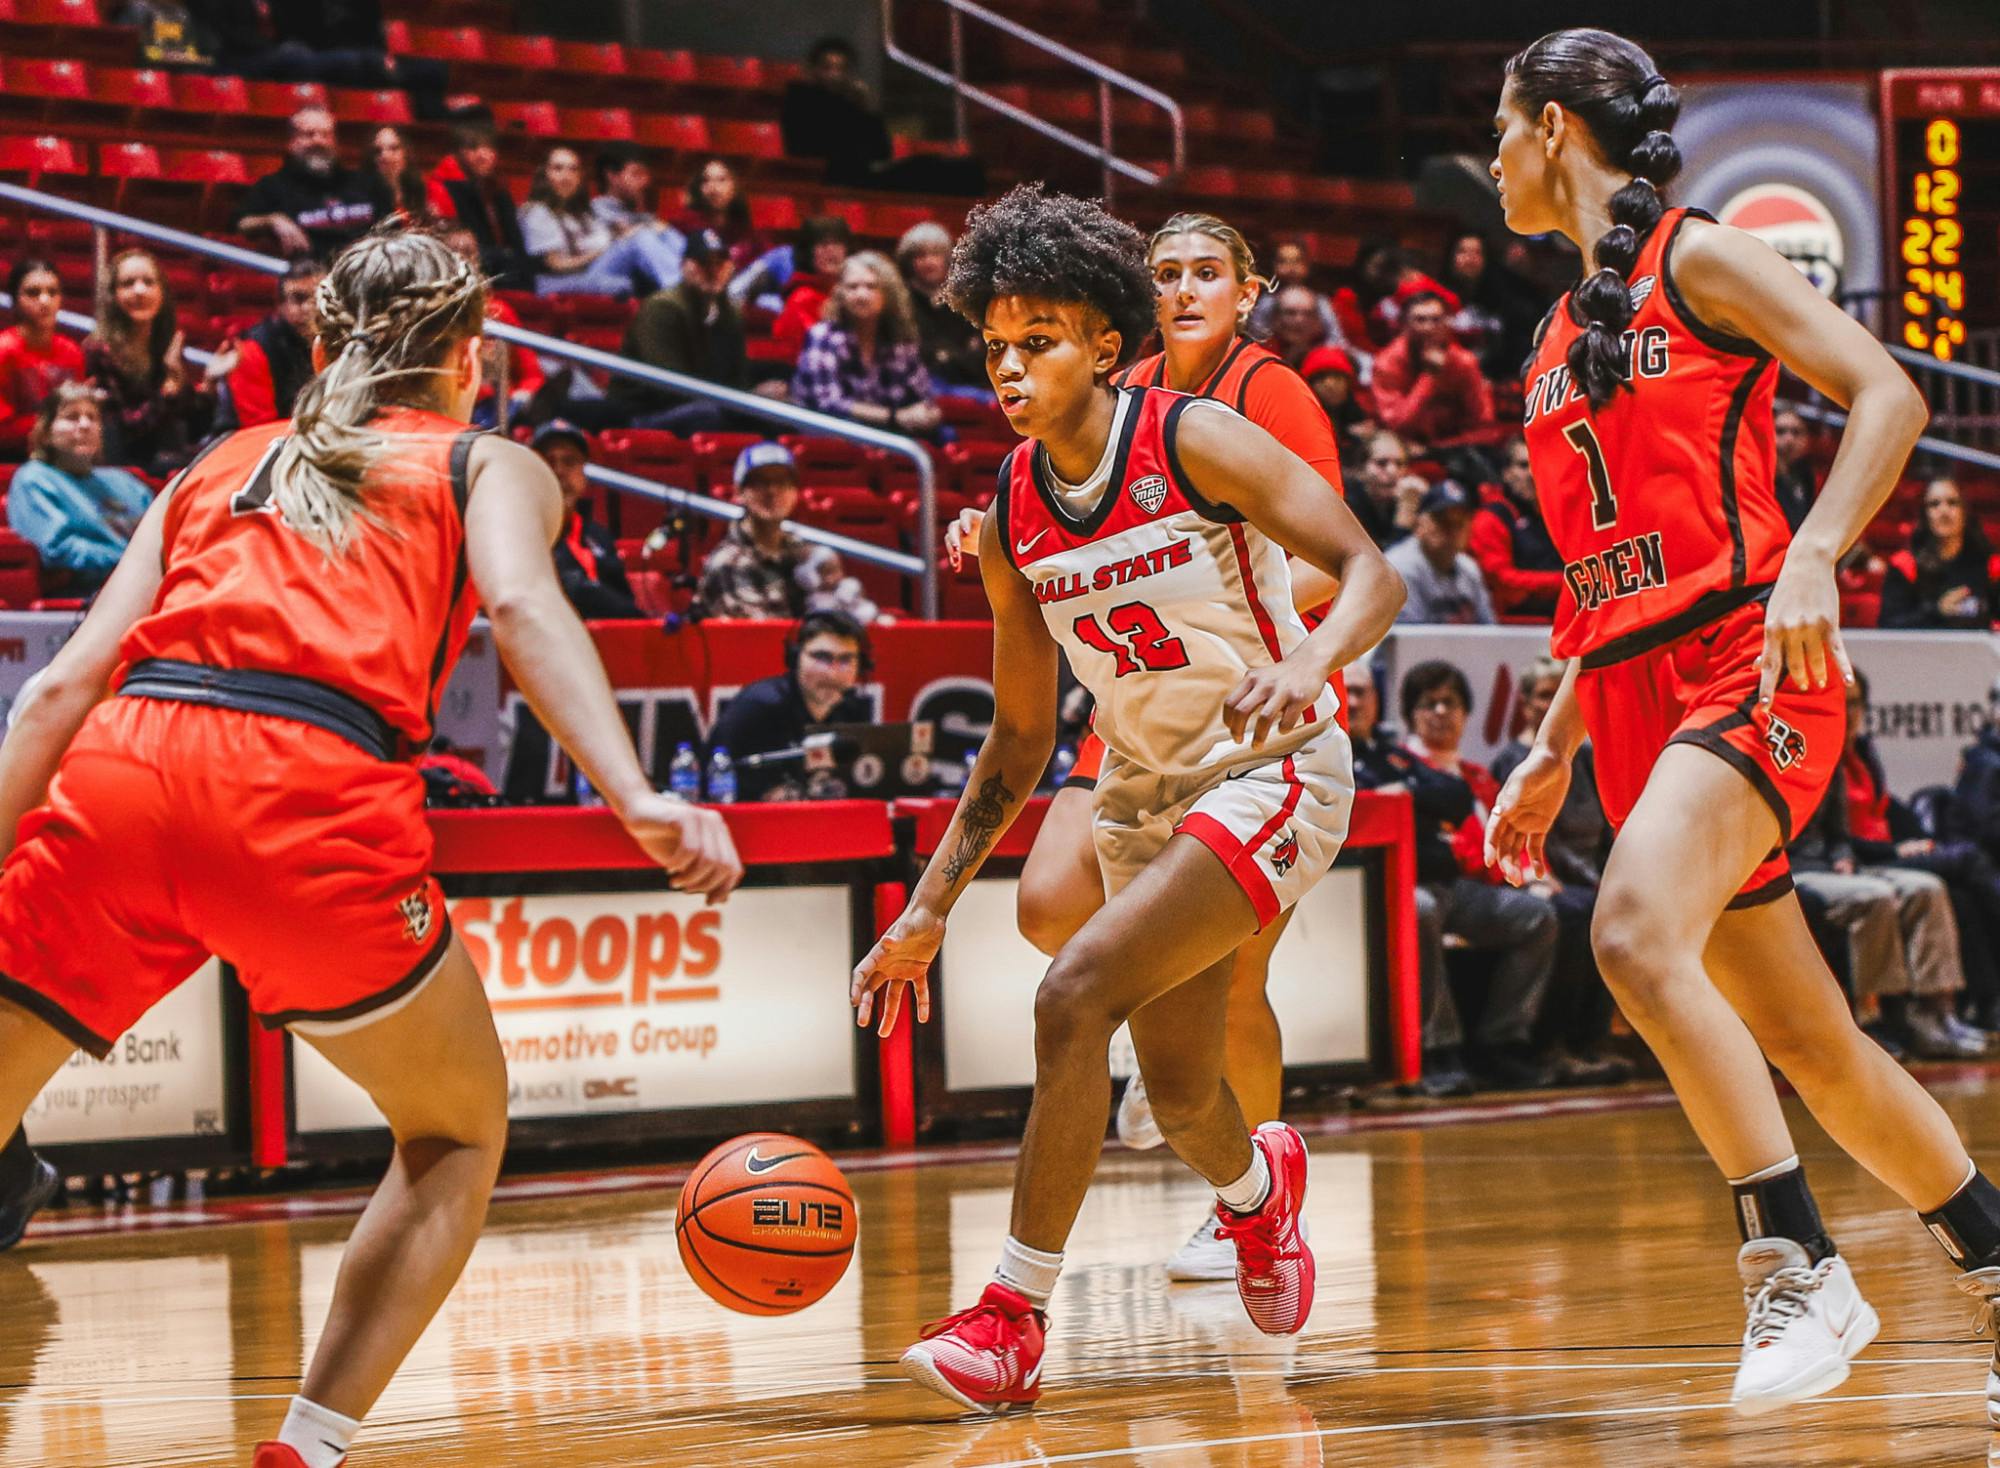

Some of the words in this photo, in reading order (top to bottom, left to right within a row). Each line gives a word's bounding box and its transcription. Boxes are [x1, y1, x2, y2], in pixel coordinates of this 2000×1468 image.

[1926, 119, 1959, 166] 0
[1914, 169, 1961, 216] 12
[1902, 217, 1963, 265] 22
[1562, 417, 1617, 531] 1
[1092, 538, 1192, 590] STATE
[1073, 600, 1191, 678] 12
[451, 896, 722, 1006] Stoops
[125, 1032, 181, 1064] Bank
[631, 1020, 718, 1059] Group
[43, 1088, 78, 1120] you
[85, 1083, 162, 1116] prosper
[752, 1200, 843, 1231] ELITE
